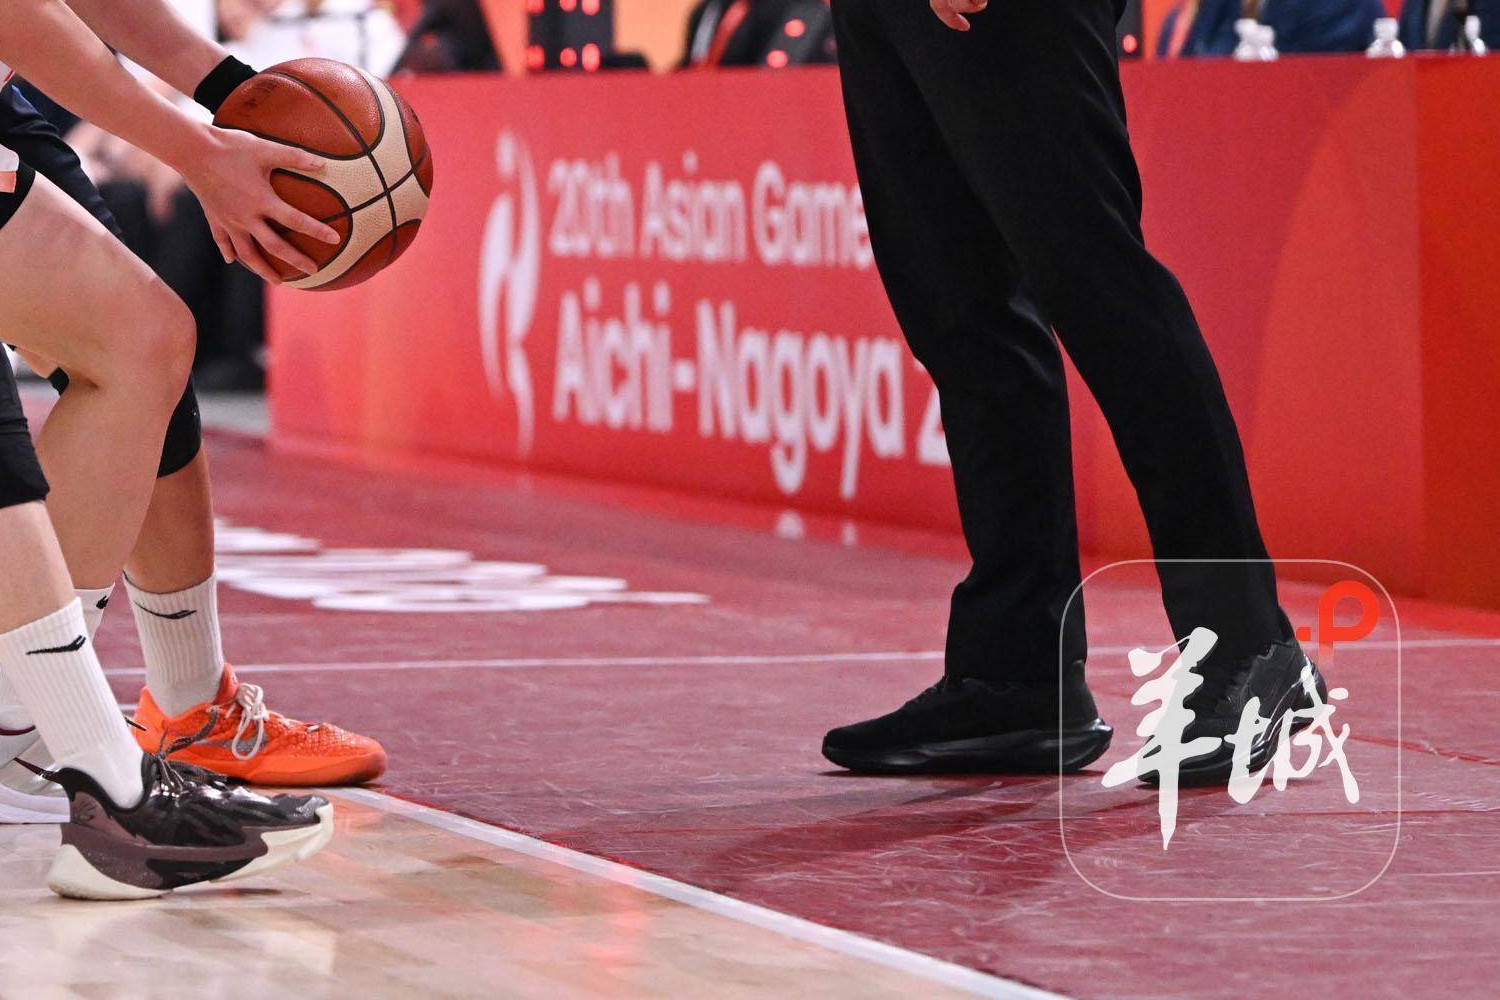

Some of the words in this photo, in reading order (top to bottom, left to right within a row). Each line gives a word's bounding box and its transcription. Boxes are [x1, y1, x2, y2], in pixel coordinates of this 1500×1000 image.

[549, 152, 633, 258] 20th
[640, 150, 748, 263] Asian
[552, 277, 904, 499] Aichi-Nagoya
